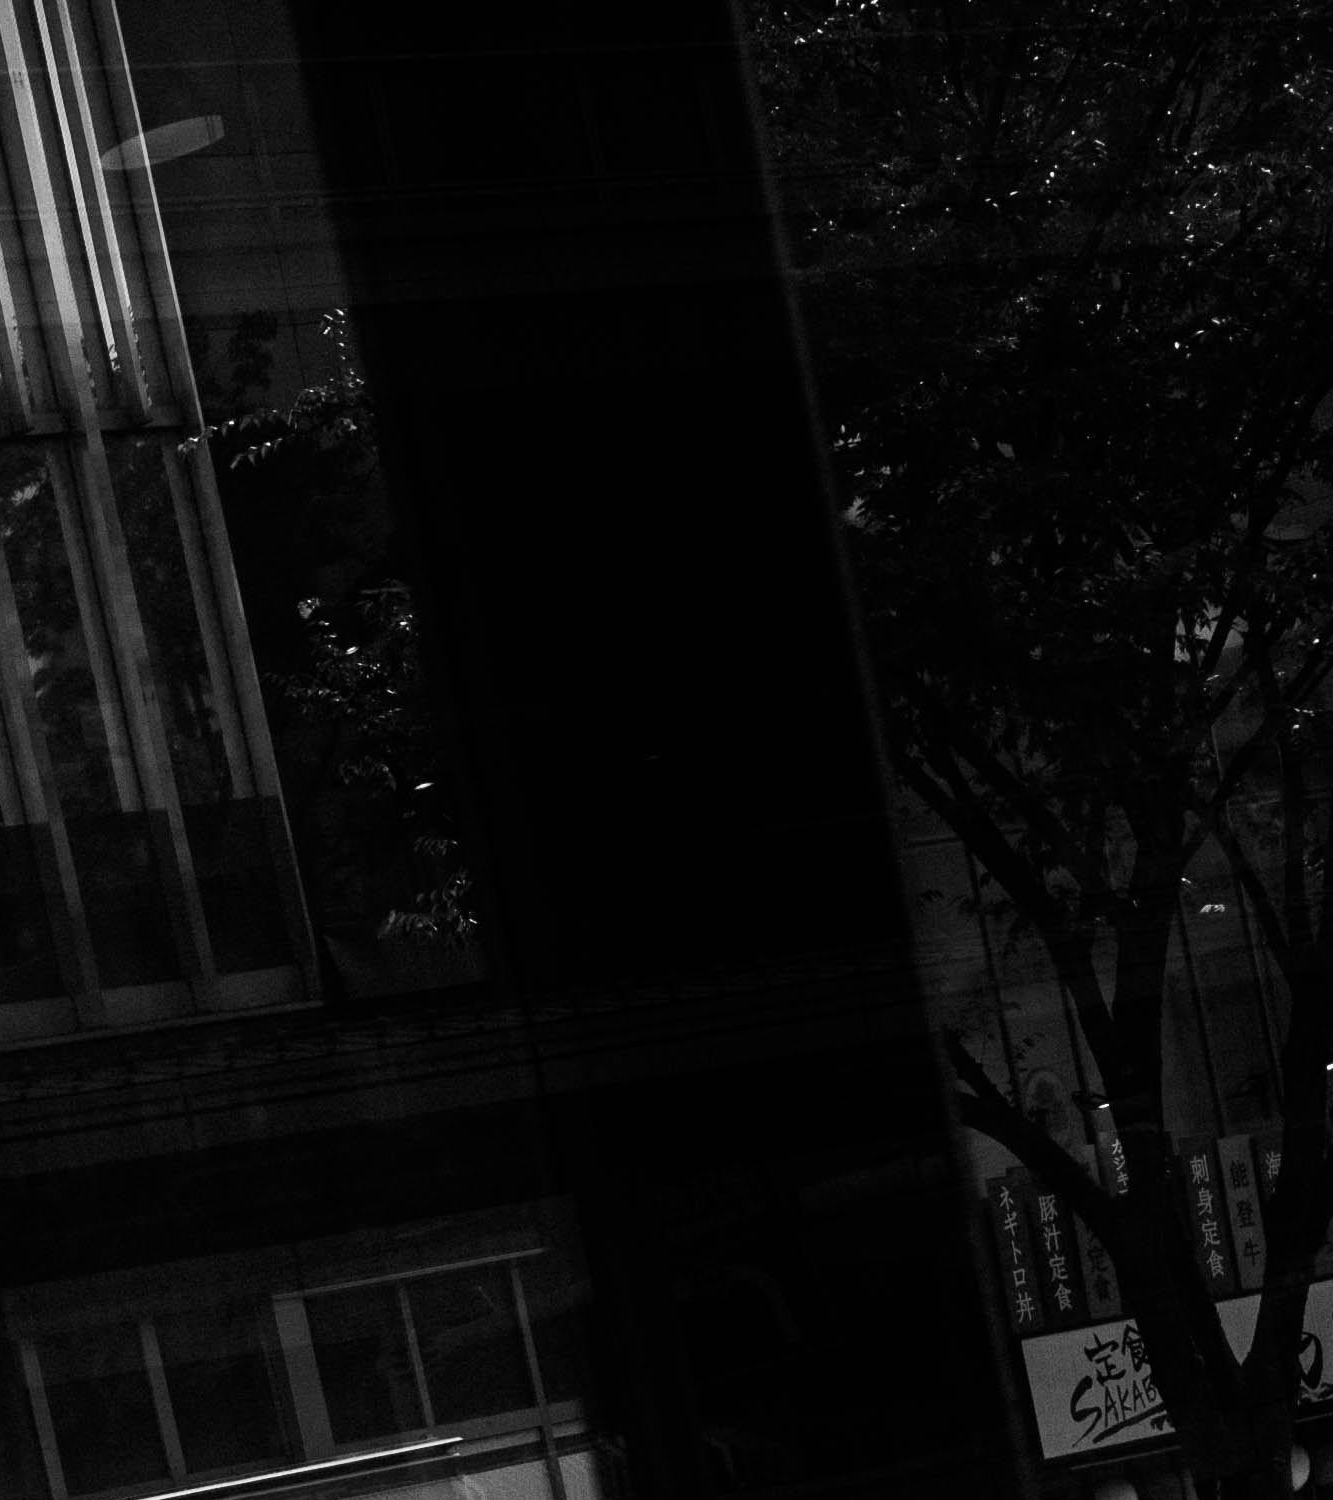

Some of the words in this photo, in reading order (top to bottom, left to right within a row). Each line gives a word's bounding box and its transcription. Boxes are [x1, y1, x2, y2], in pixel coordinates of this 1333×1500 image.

[1000, 1185, 1035, 1323] ネギトロ丼
[1038, 1194, 1073, 1312] 豚汁定食
[1190, 1154, 1225, 1278] 刺身定食
[1229, 1160, 1261, 1266] 能登牛
